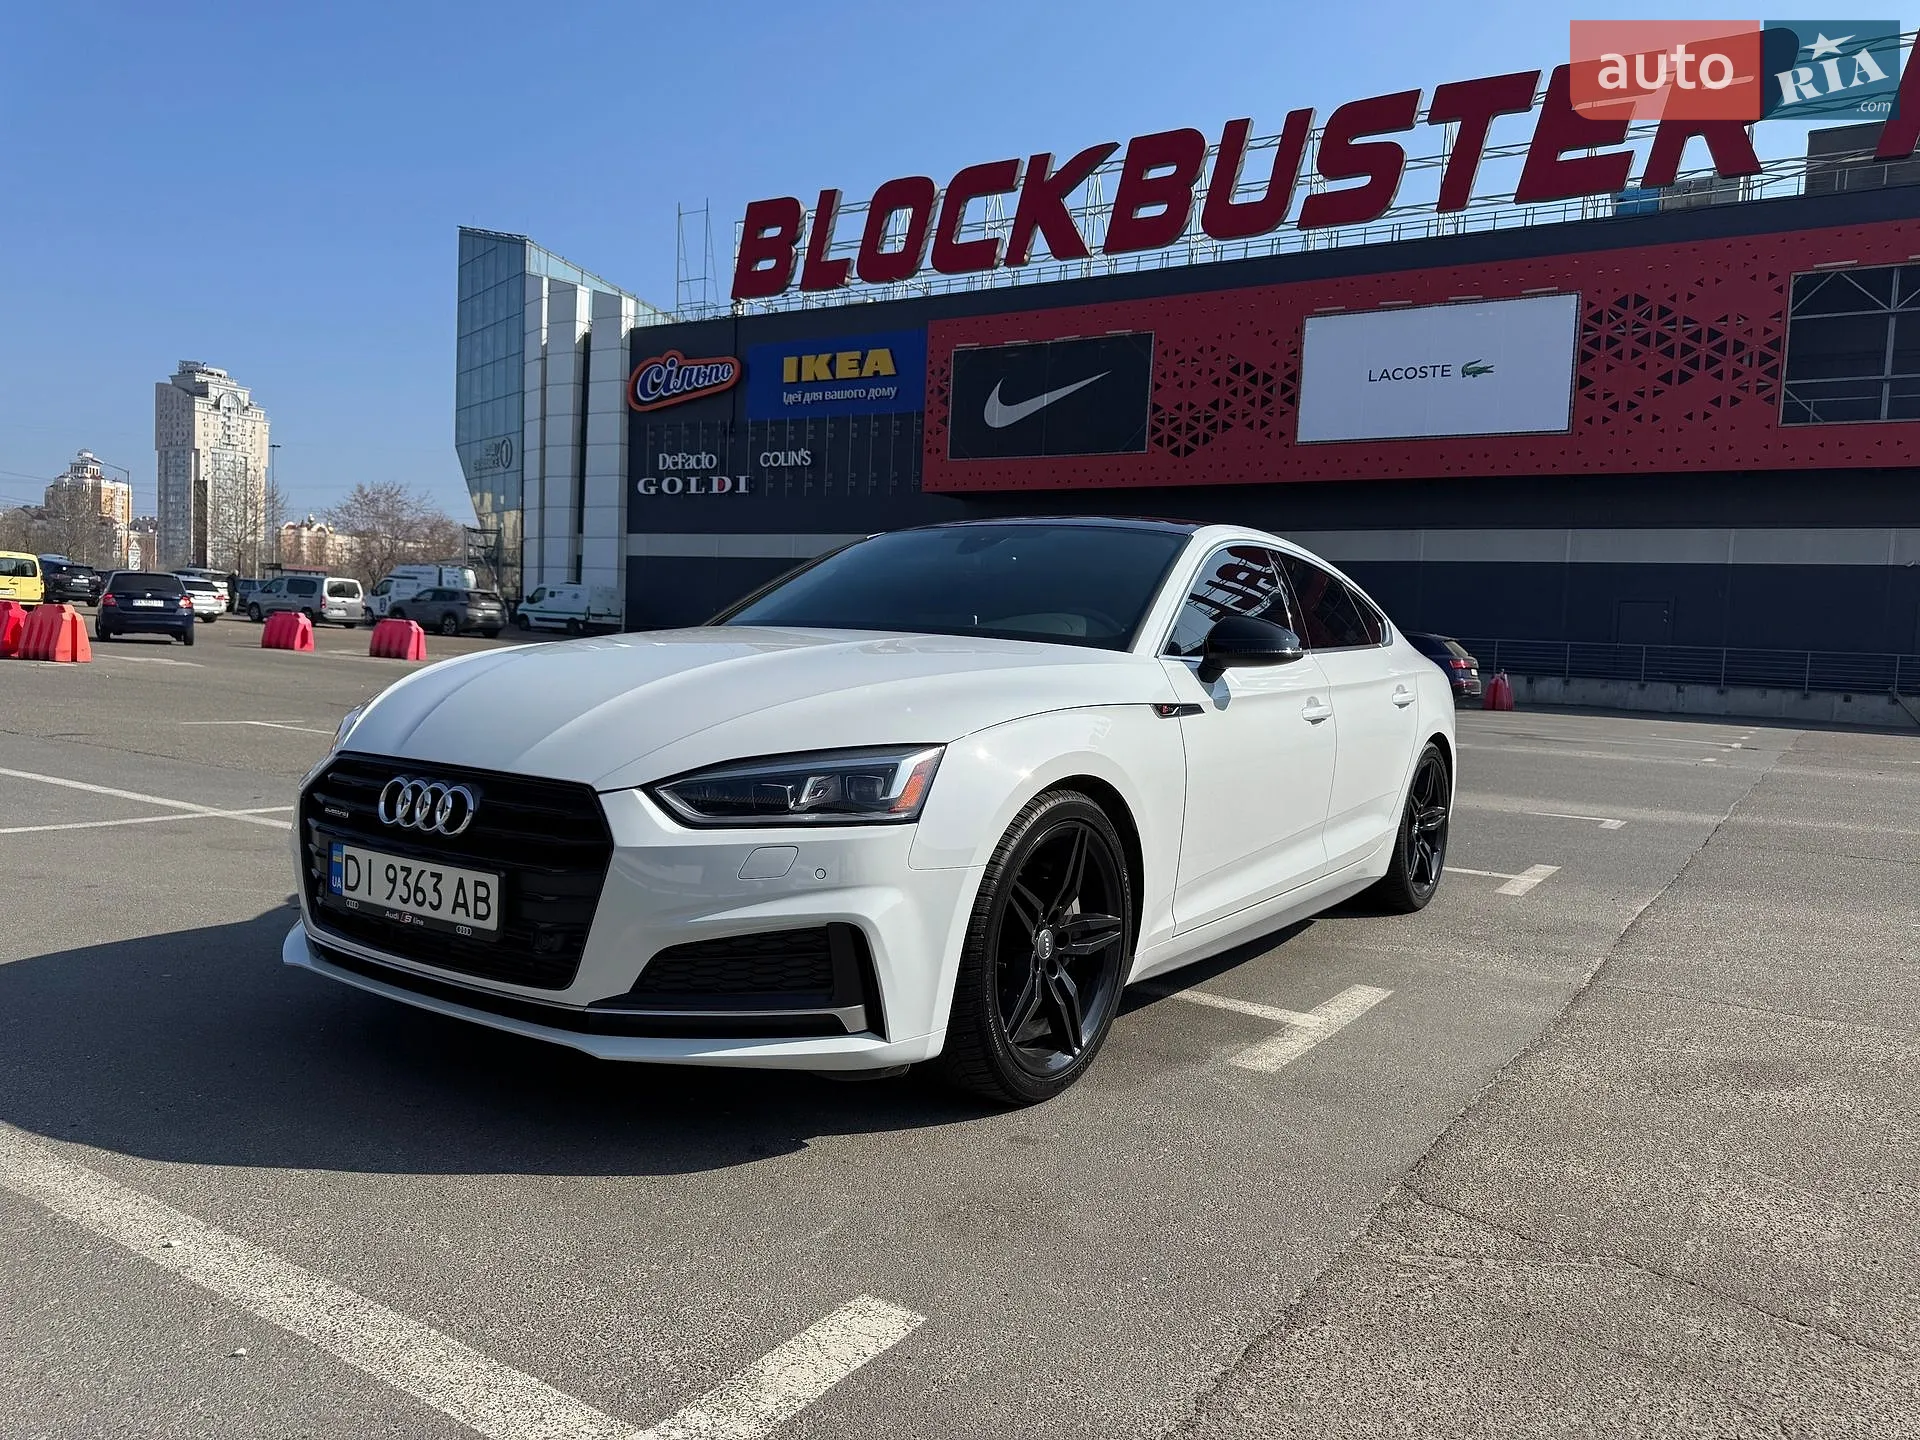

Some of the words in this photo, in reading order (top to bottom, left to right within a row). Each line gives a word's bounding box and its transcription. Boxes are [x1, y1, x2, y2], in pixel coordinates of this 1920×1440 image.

[731, 29, 1799, 301] BLOCKBUSTER
[783, 348, 897, 383] IKEA
[1368, 364, 1452, 382] LACOSTE
[637, 357, 733, 402] Сільпо
[803, 391, 823, 404] для
[824, 388, 866, 401] вашого
[867, 386, 898, 400] дому
[658, 451, 718, 471] DeFacto
[759, 448, 812, 468] COLIN'S
[637, 475, 750, 495] GOLDI
[332, 876, 342, 889] UA
[344, 853, 372, 896] DI
[385, 863, 443, 911] 9363
[451, 877, 491, 921] AB
